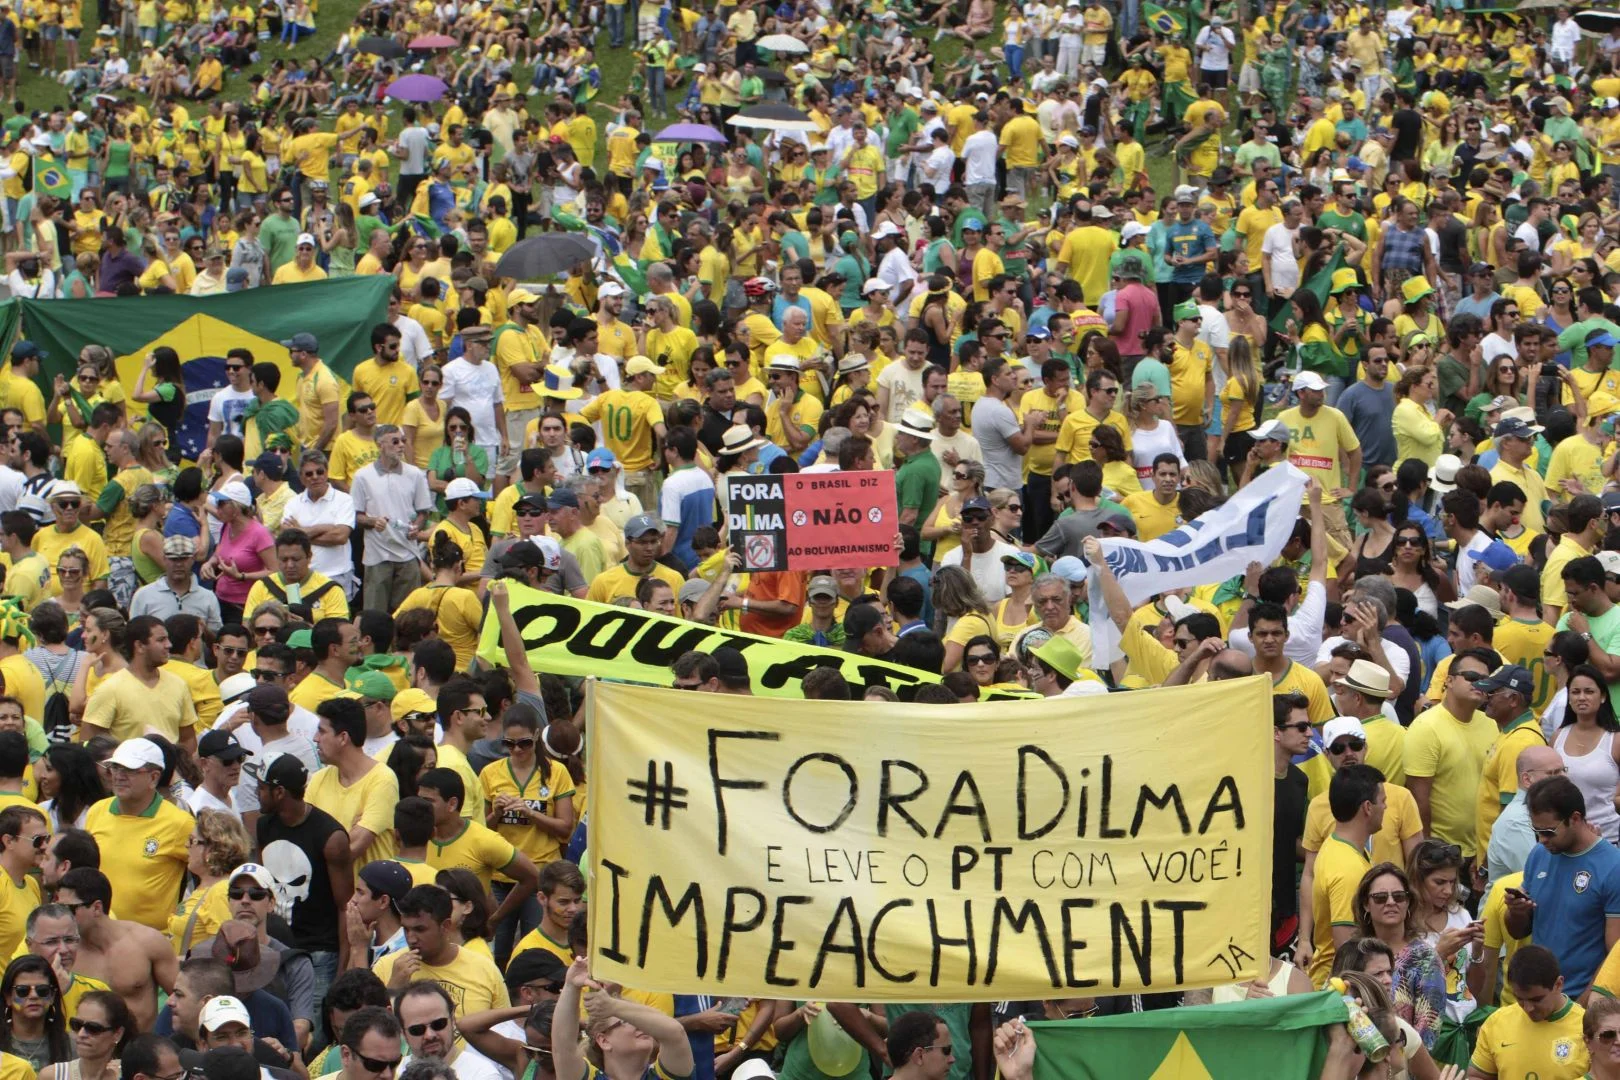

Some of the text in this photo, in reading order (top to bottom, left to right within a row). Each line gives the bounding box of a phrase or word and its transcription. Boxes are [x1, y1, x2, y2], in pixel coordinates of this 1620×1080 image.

[608, 403, 632, 441] 10
[730, 483, 784, 500] FORA
[796, 478, 878, 489] O BRASIL DIZ
[813, 502, 862, 525] NÃO
[788, 544, 890, 556] AO BOLIVARIANISMO
[767, 839, 1242, 891] E LEVE O PT COM VOCÊ!
[599, 858, 1255, 989] IMPEACHMENT JÁ
